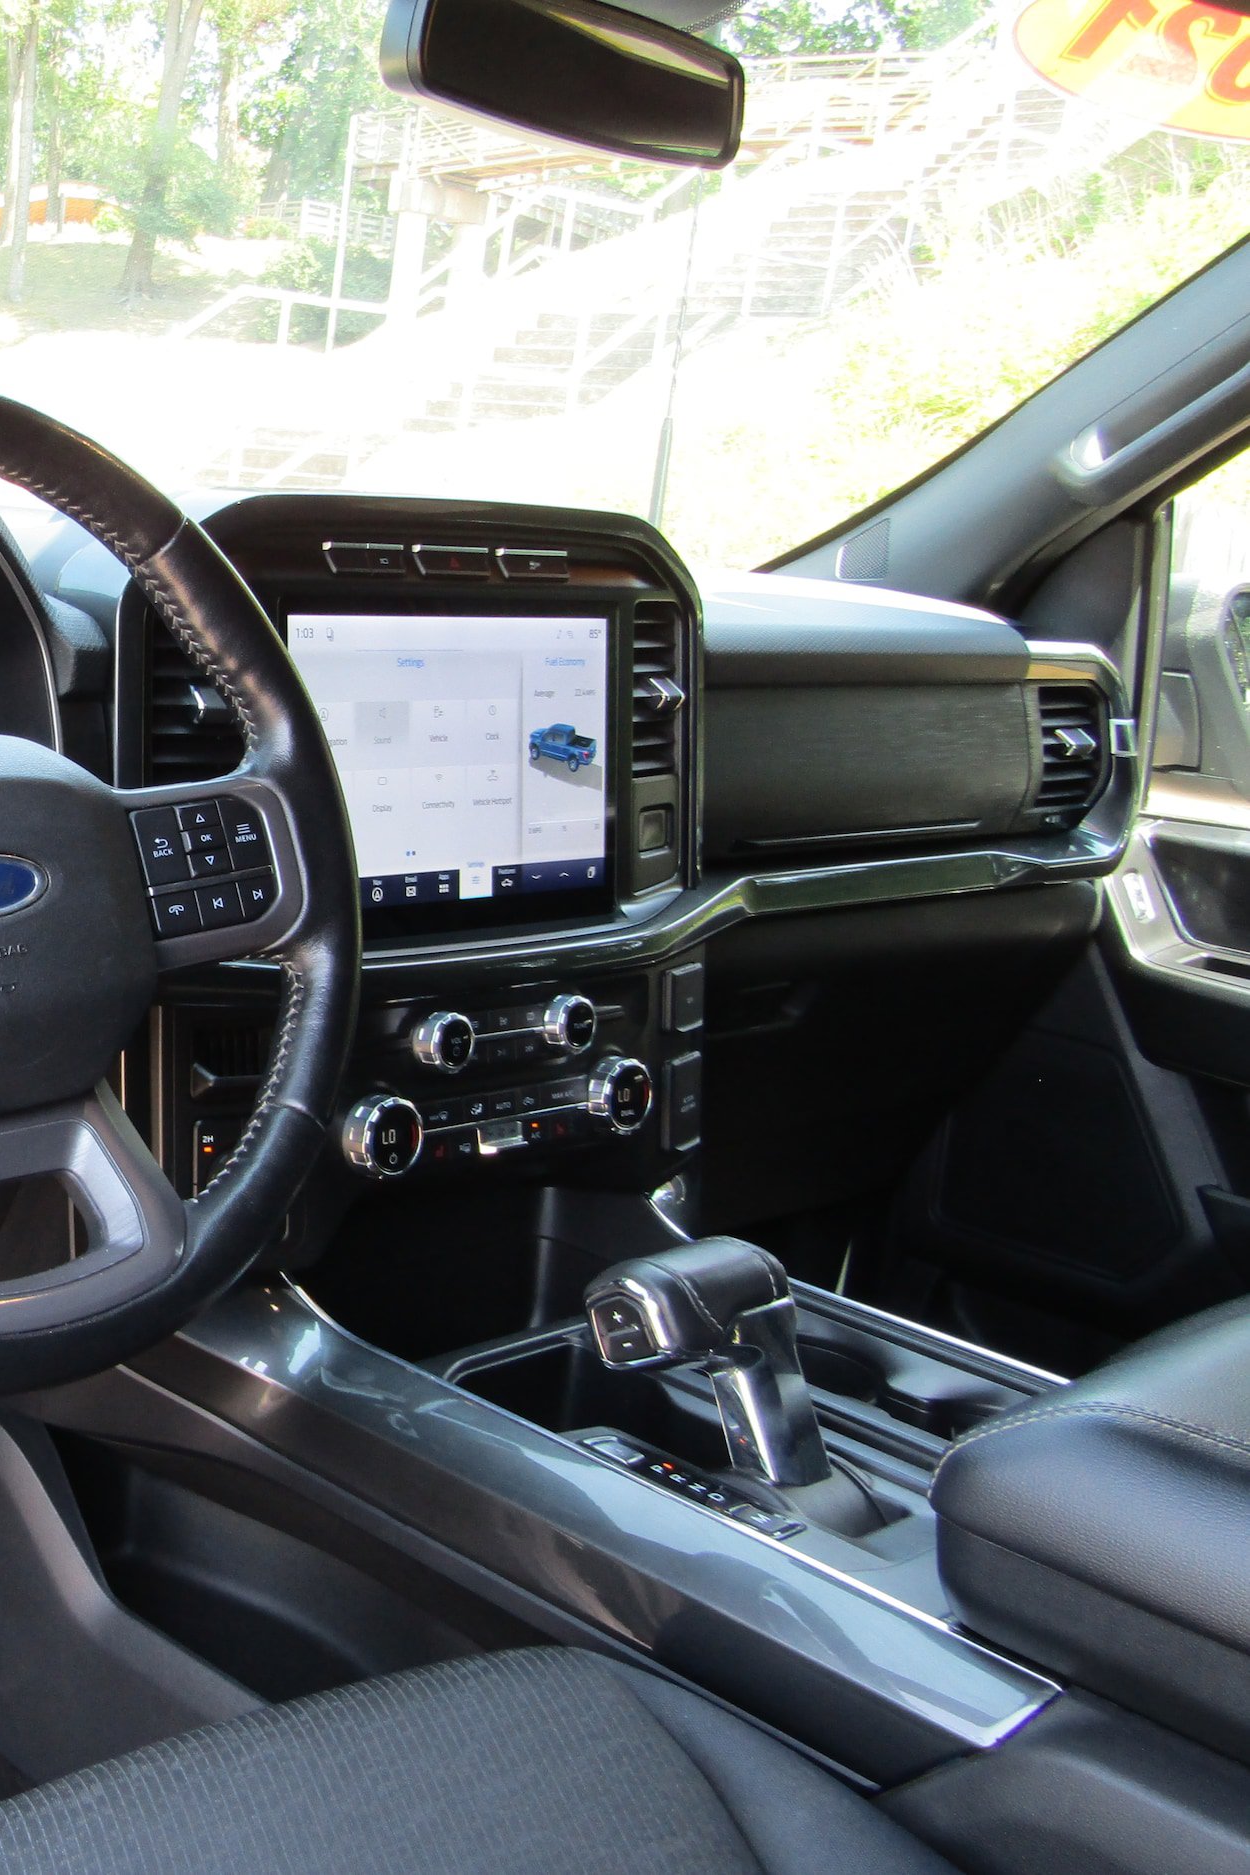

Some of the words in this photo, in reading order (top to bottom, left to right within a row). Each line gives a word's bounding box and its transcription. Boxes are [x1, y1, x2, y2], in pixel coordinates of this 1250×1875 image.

[296, 628, 314, 639] 1:03
[397, 657, 425, 669] Settings
[374, 735, 392, 745] Sound
[200, 834, 213, 842] OK
[235, 833, 257, 843] MENU
[152, 848, 174, 858] BACK
[617, 1087, 631, 1103] LO
[496, 1101, 511, 1110] AUTO
[202, 1135, 214, 1143] 2H
[381, 1128, 396, 1145] LO
[650, 1464, 664, 1474] P
[669, 1473, 687, 1484] R
[688, 1482, 707, 1493] N
[707, 1492, 726, 1502] D
[750, 1513, 771, 1524] M
